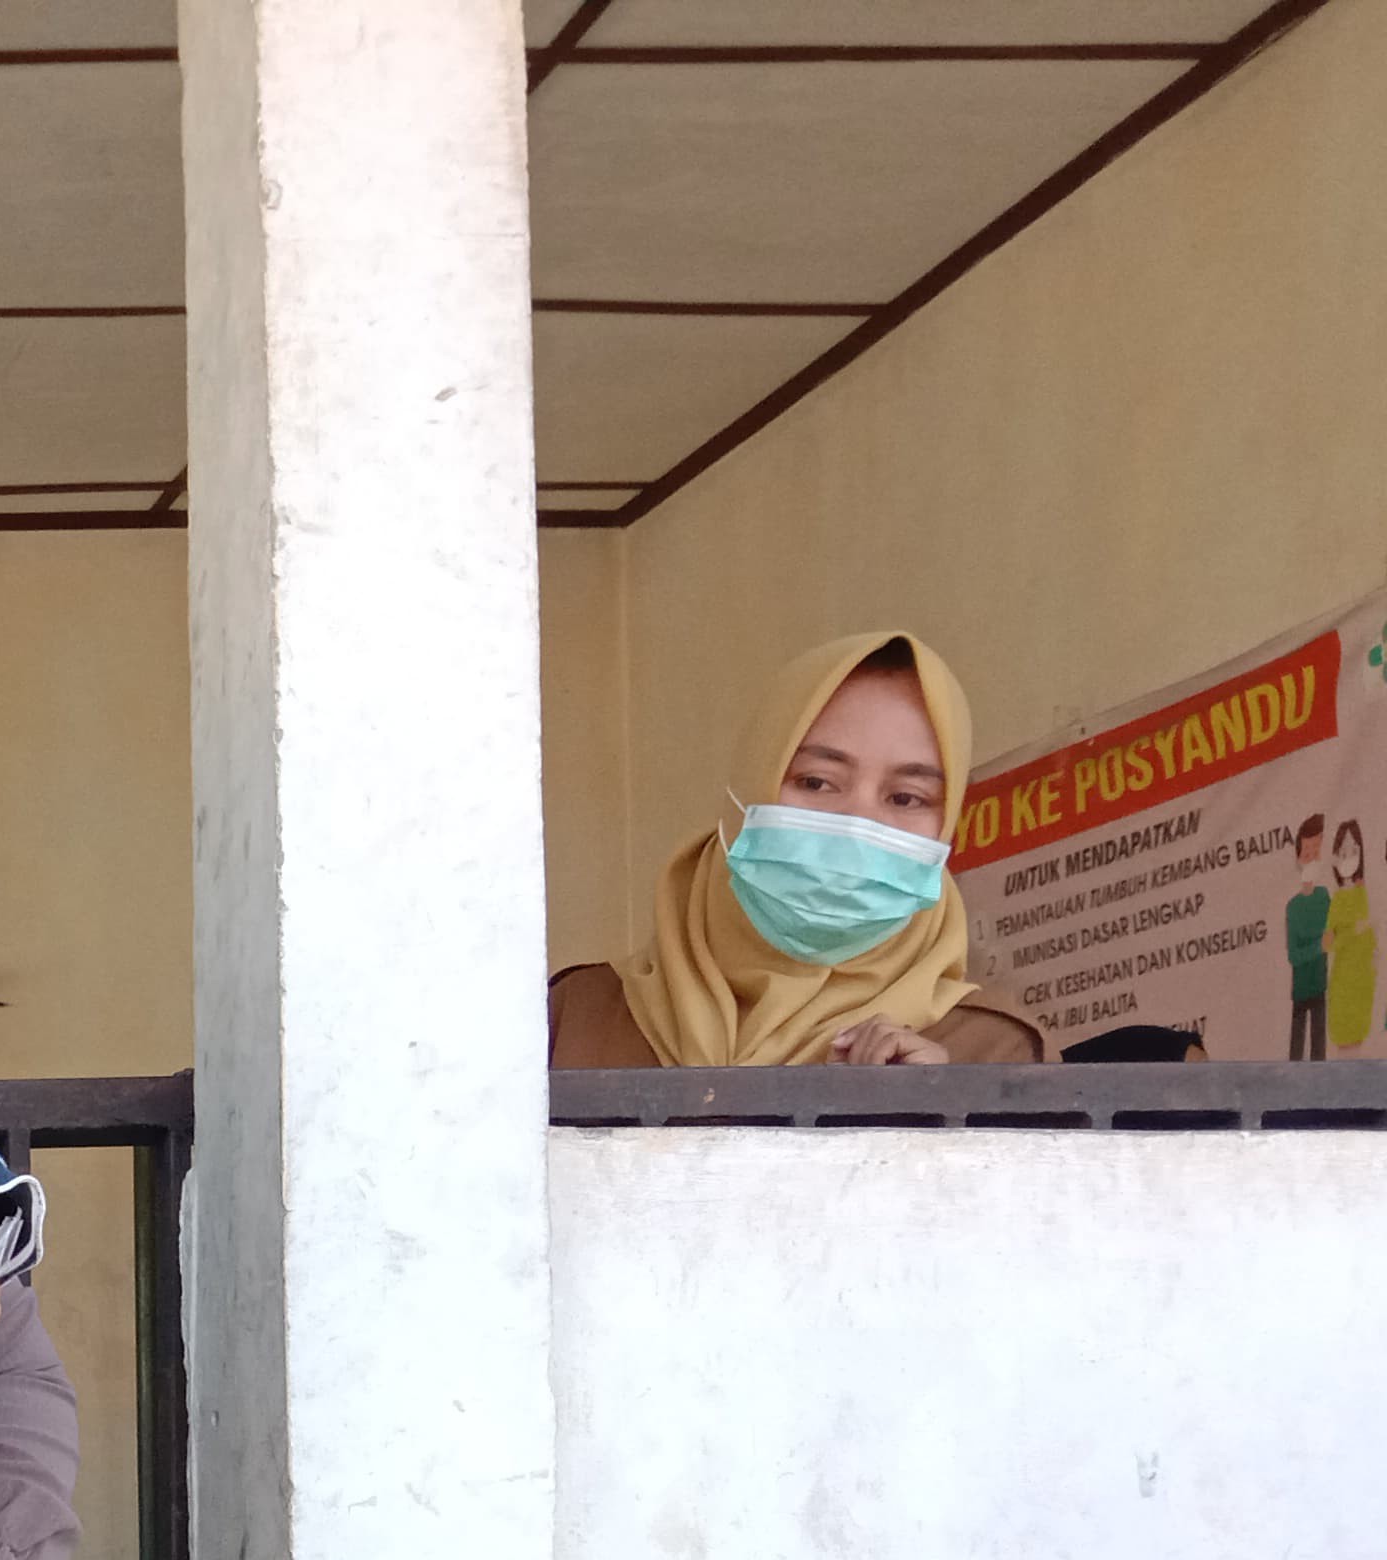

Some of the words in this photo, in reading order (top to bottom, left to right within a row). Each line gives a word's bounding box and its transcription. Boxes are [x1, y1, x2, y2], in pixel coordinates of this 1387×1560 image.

[1011, 771, 1064, 836] KE
[1074, 665, 1316, 814] POSYANDU
[995, 893, 1089, 938] PEMANTAUAN
[1089, 872, 1148, 909] TUMBUH
[1150, 843, 1231, 885] KEMBANG
[1234, 825, 1295, 864] BALITA
[1004, 862, 1061, 897] UNTUK
[1065, 808, 1202, 878] MENDAPATKAN
[1012, 931, 1077, 970] IMUNISASI
[1081, 916, 1129, 946] DASAR
[1132, 892, 1206, 928] LENGKAP
[1023, 982, 1052, 1006] CEK
[1056, 959, 1133, 998] KESEHATAN
[1138, 949, 1172, 977] DAN
[1176, 920, 1268, 966] KONSELING
[1065, 1003, 1088, 1028] IBU
[1091, 990, 1138, 1022] BALITA
